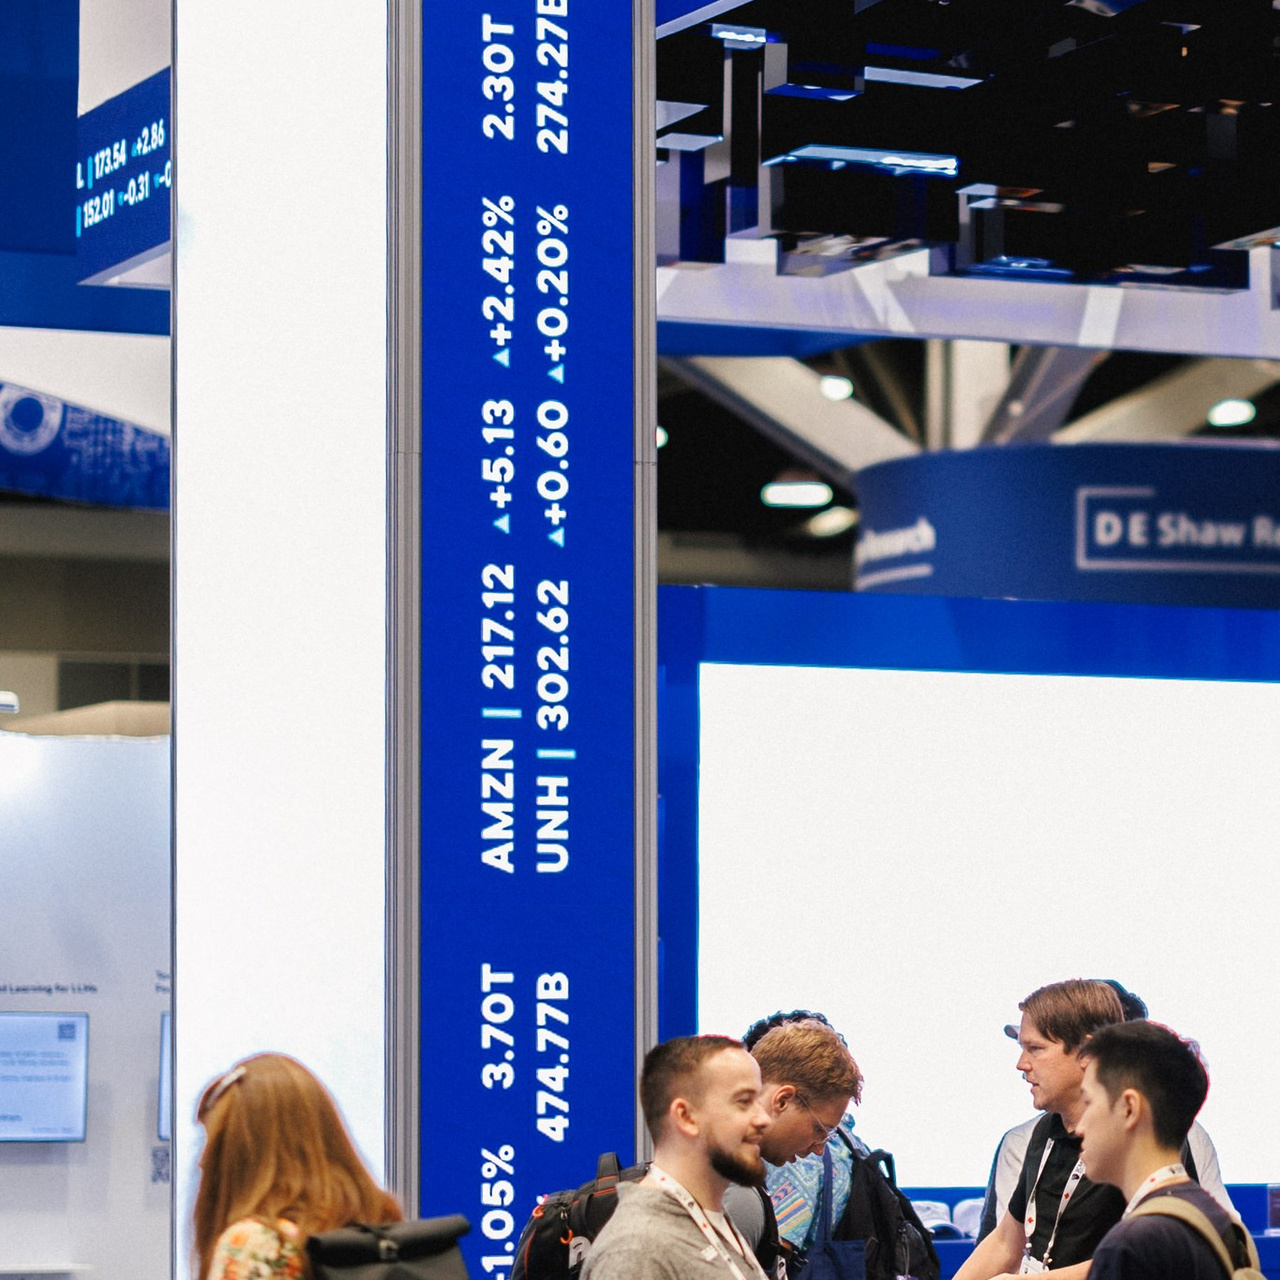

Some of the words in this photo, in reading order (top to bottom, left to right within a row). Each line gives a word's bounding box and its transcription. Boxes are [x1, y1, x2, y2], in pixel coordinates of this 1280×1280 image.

[483, 14, 514, 139] 2.30T
[84, 190, 113, 227] 152.01
[124, 172, 148, 204] -0.31
[95, 140, 126, 178] 173.54
[137, 120, 164, 154] +2.86
[482, 196, 514, 345] +2.42%
[537, 205, 568, 361] +0.20%
[482, 400, 514, 508] +5.13
[537, 401, 568, 524] +0.60
[1094, 510, 1119, 548] D
[1127, 512, 1149, 548] E
[1156, 512, 1244, 548] Shaw
[482, 565, 514, 689] 217.12
[537, 581, 568, 730] 302.62
[481, 740, 514, 873] AMZN
[536, 777, 568, 872] UNH
[482, 964, 514, 1088] 3.70T
[537, 973, 569, 1141] 474.77B
